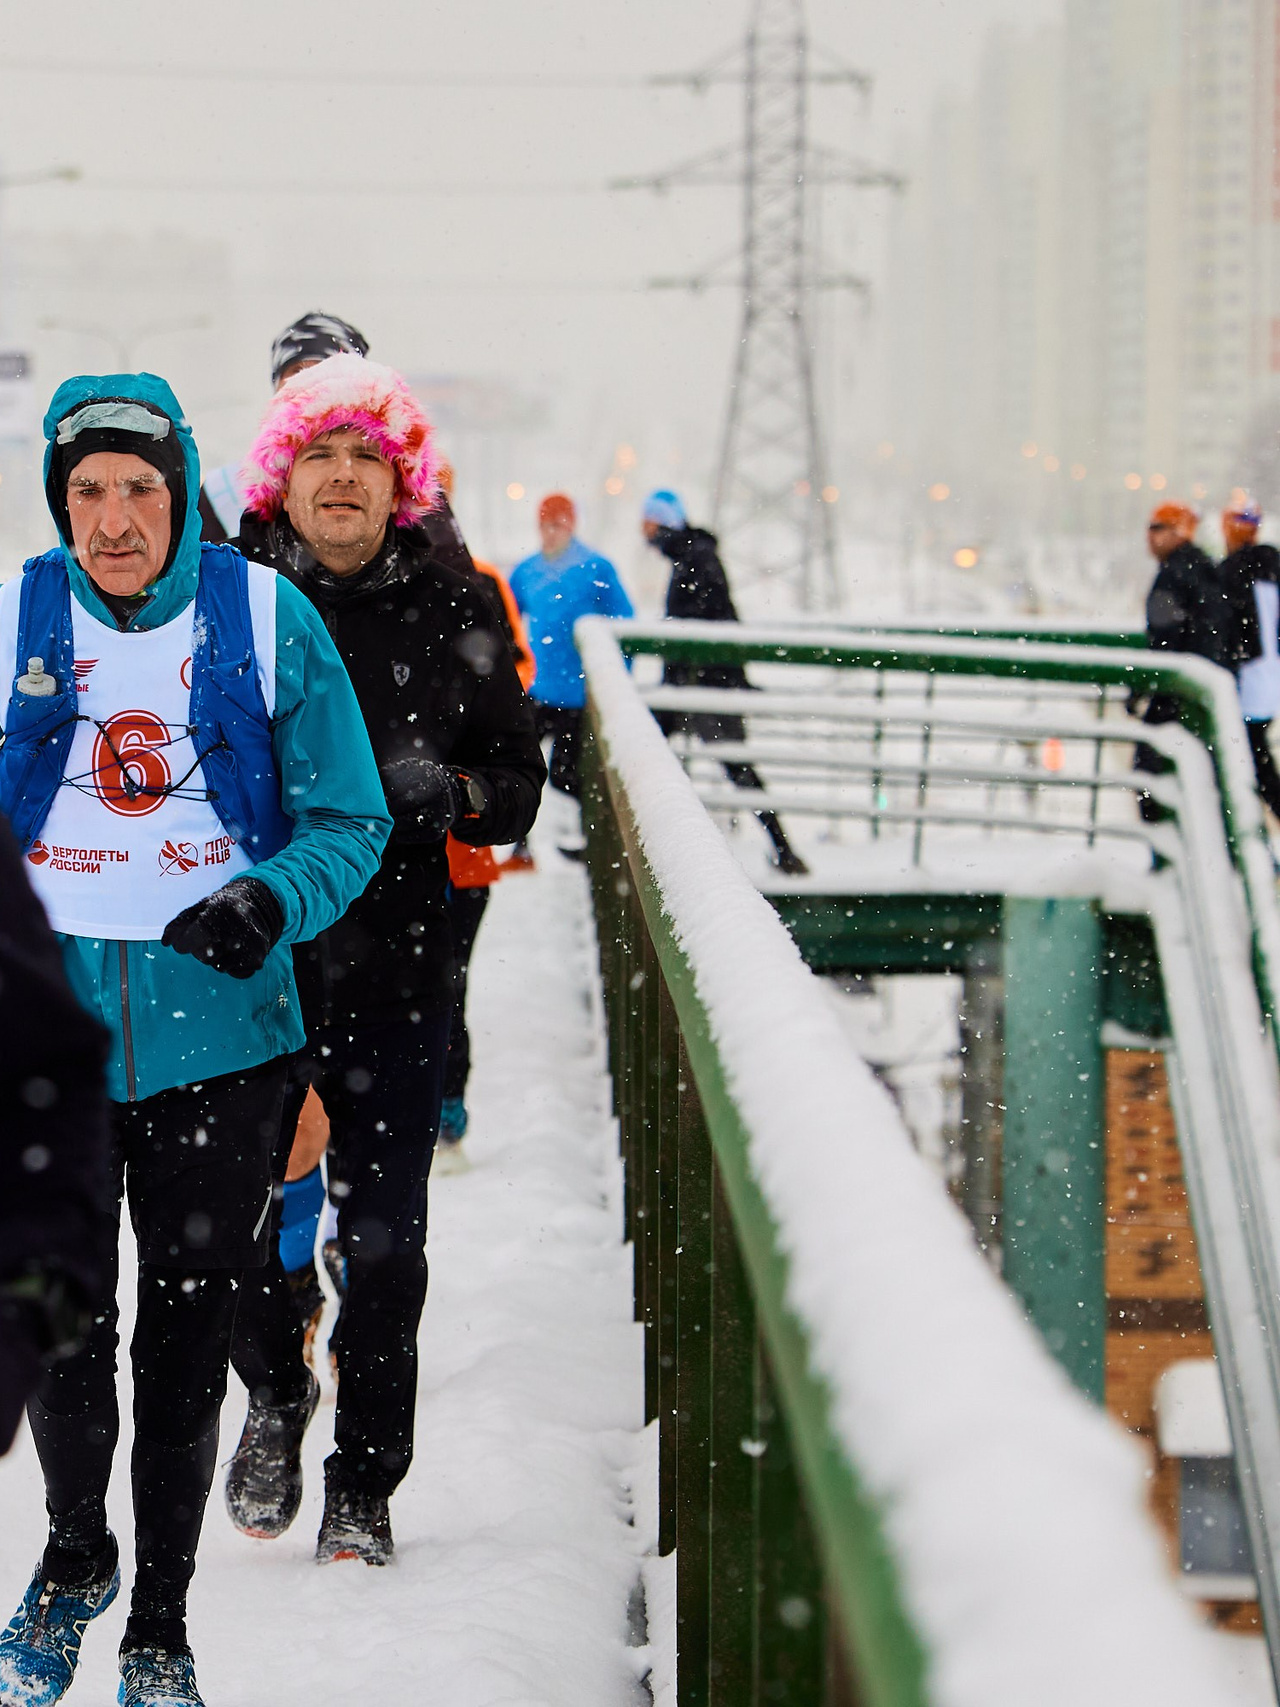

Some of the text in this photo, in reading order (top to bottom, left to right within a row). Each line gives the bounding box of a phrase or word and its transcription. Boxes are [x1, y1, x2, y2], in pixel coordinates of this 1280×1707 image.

[92, 709, 171, 817] 6
[52, 845, 129, 862] ВЕРТОЛЕТЫ
[204, 848, 231, 866] НЦВ
[49, 858, 101, 874] РОССИИ
